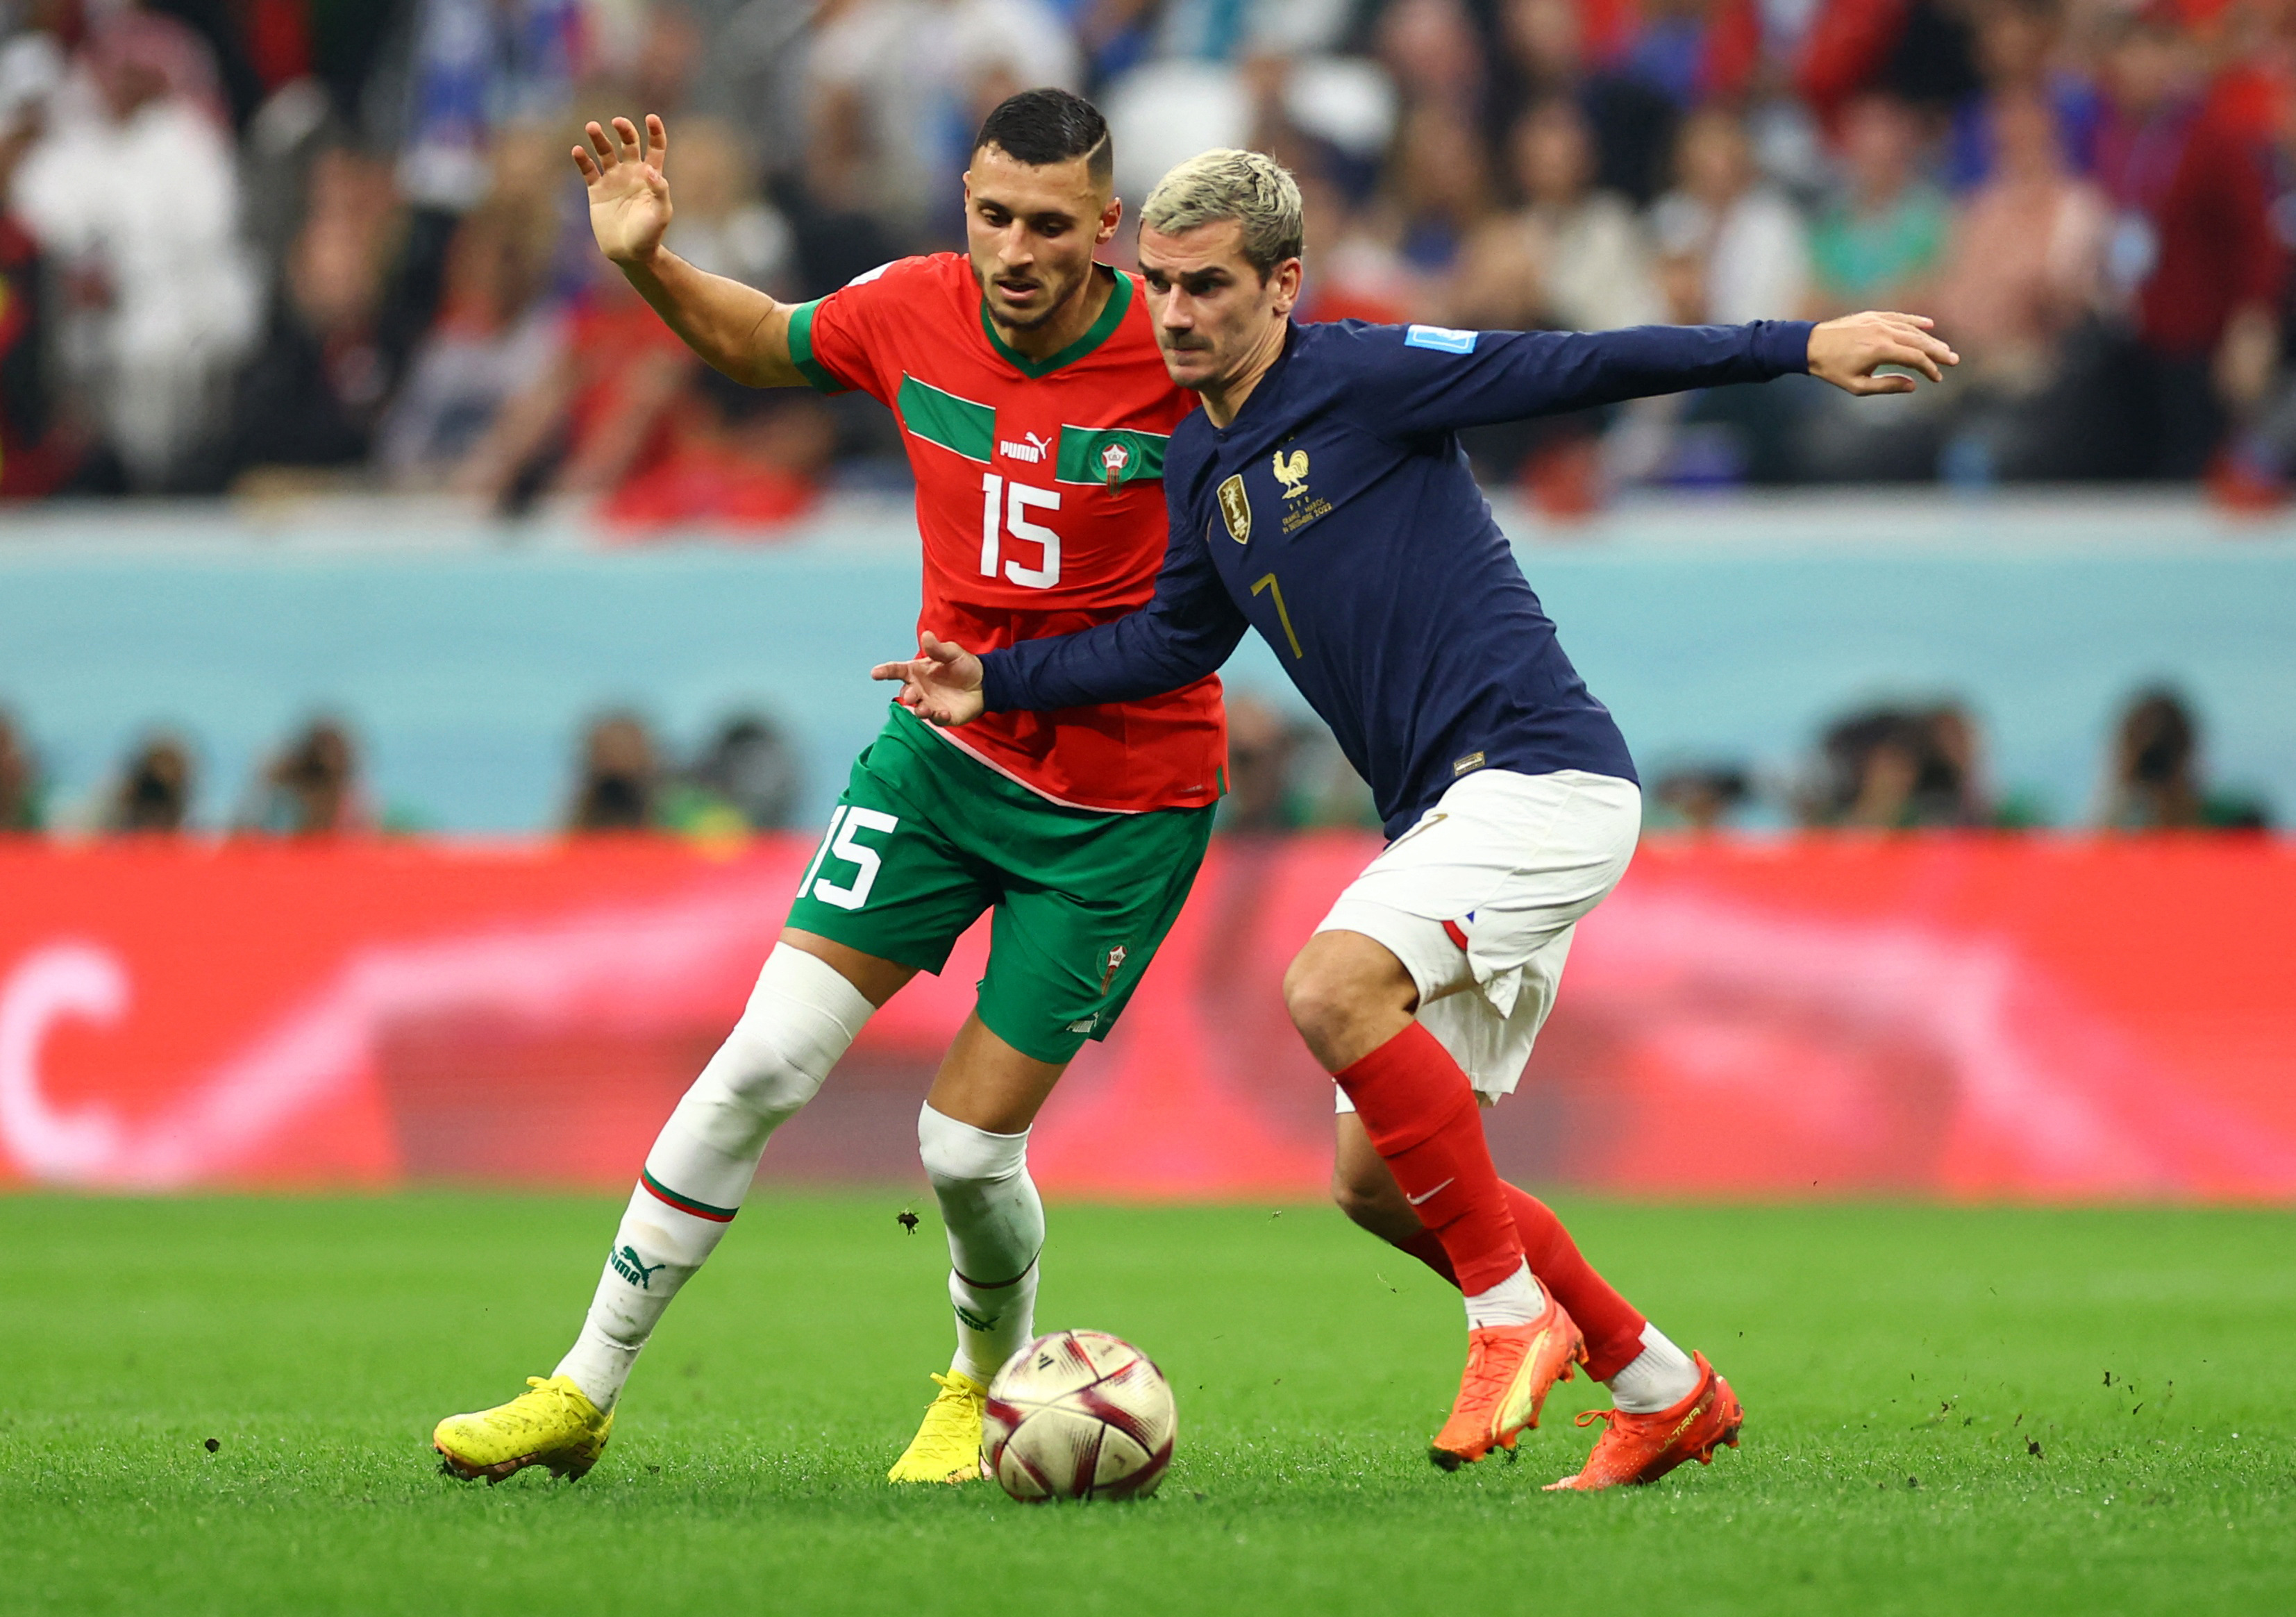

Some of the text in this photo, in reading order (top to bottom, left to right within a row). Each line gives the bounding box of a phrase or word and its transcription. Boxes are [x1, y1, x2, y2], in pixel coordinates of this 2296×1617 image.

[1000, 440, 1039, 463] PUMA
[980, 473, 1061, 589] 15
[1250, 573, 1303, 659] 7
[796, 805, 900, 911] 15
[611, 1241, 641, 1287] UMA
